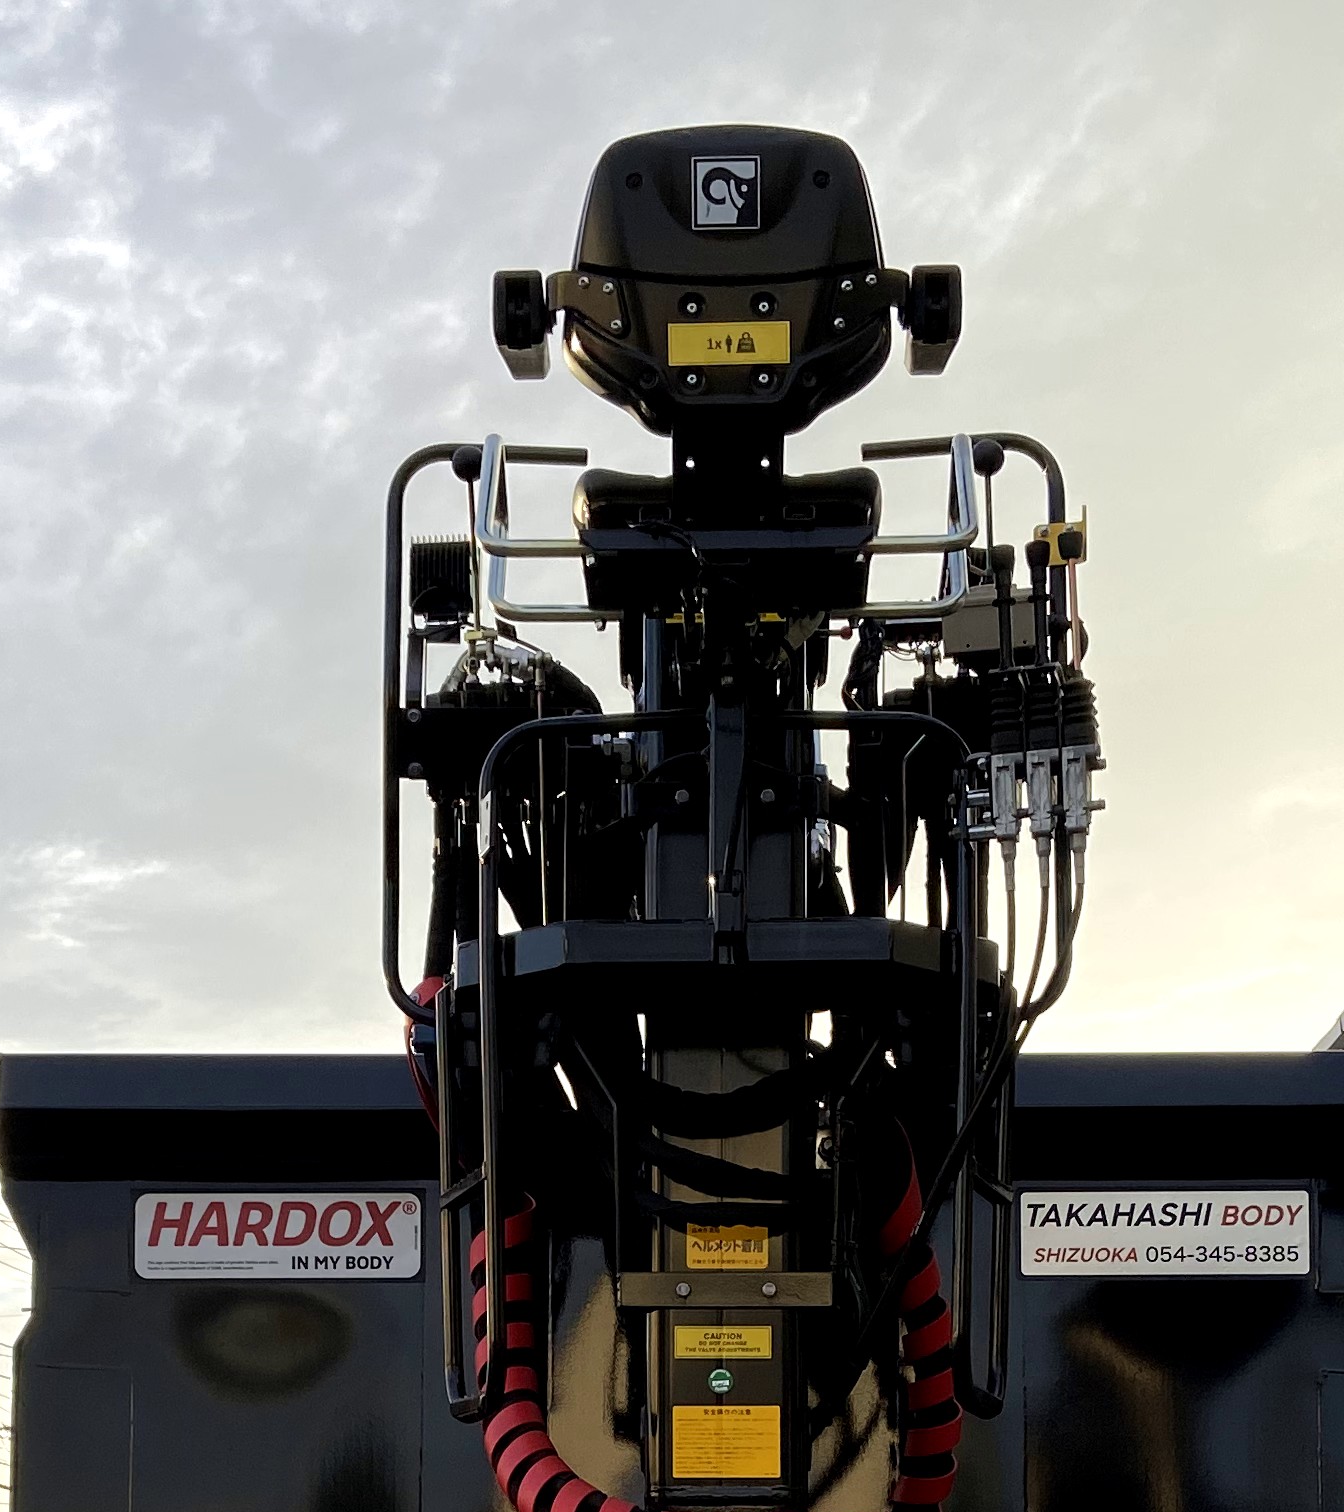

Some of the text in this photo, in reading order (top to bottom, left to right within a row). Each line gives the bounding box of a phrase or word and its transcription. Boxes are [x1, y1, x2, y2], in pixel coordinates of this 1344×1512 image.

[1026, 1202, 1304, 1227] TAKAHASHI BODY
[1033, 1245, 1300, 1263] SHIZUOKA 054-345-8385
[291, 1255, 394, 1270] IN MY BODY
[703, 1332, 743, 1340] CAUTION
